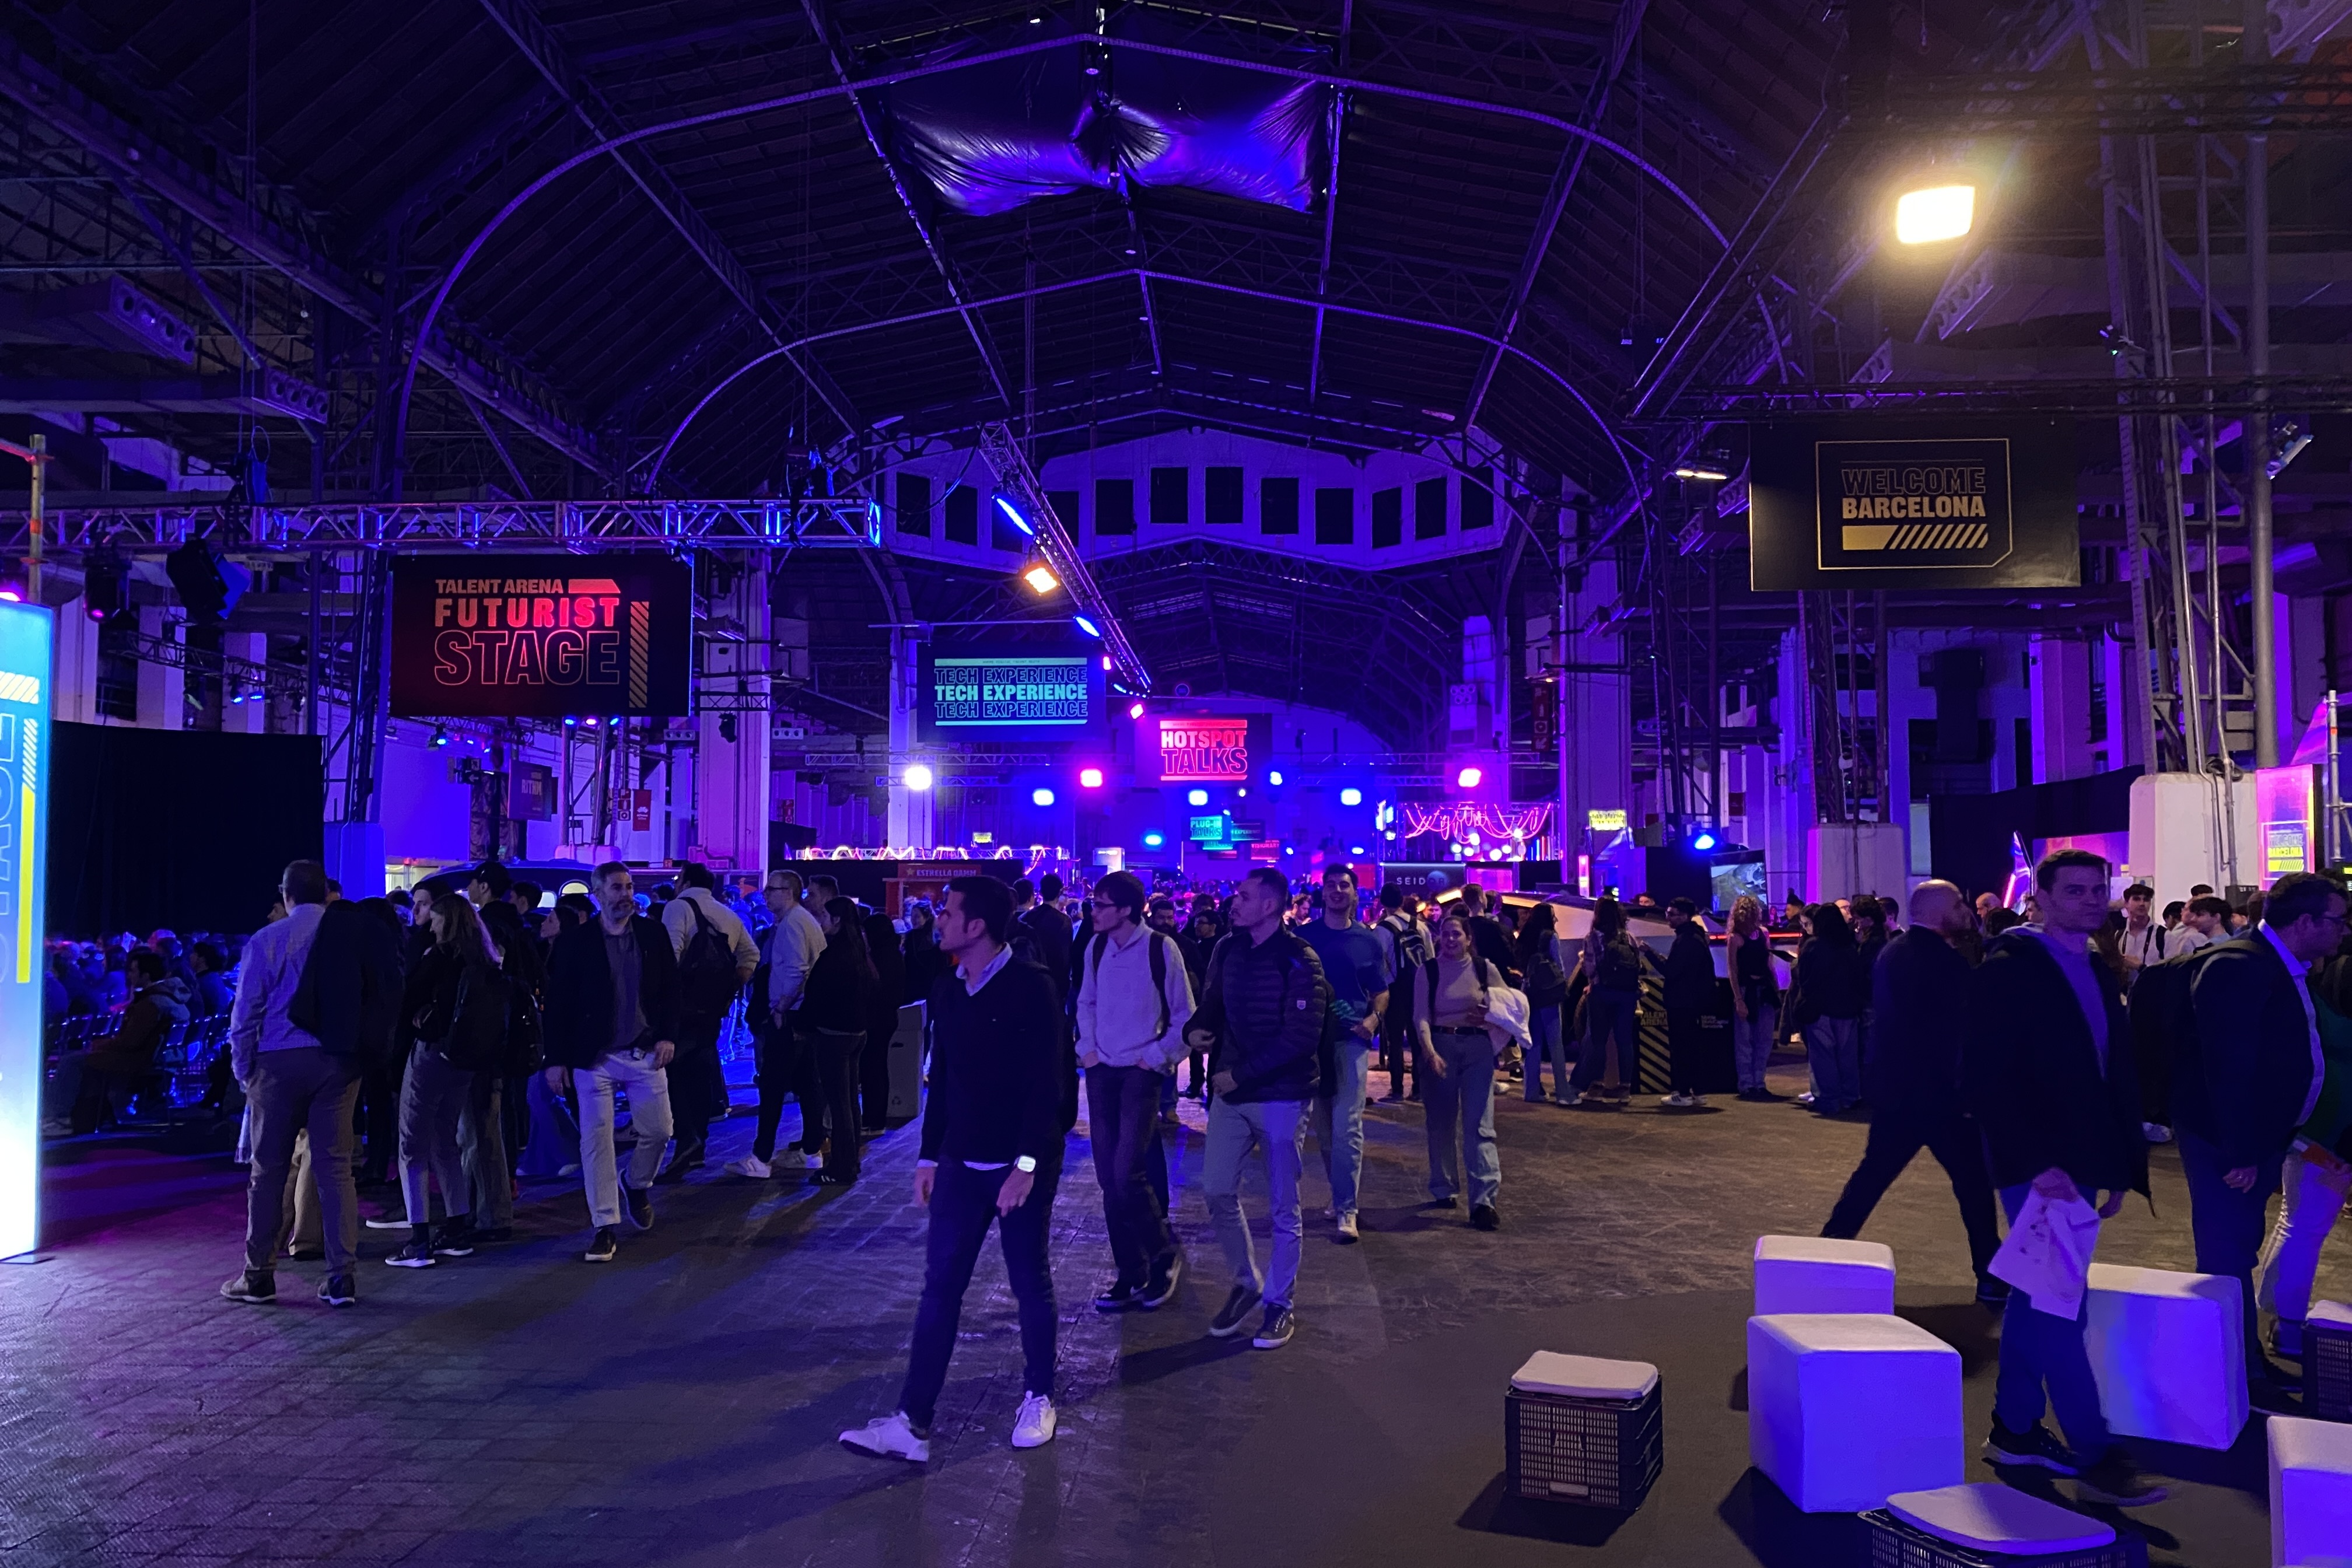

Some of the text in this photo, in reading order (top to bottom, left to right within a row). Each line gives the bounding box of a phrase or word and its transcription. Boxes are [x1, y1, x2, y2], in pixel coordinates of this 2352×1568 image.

[1842, 467, 1986, 495] WELCOME
[1842, 496, 1986, 519] BARCELONA
[436, 579, 564, 593] TALENT ARENA
[435, 597, 620, 627] FUTURIST
[435, 629, 620, 685] STAGE
[935, 667, 1087, 684] TECH EXPERIENCE
[935, 684, 1087, 701] TECH EXPERIENCE
[935, 701, 1088, 718] TECH EXPERIENCE
[1161, 730, 1247, 748] HOTSPOT
[1161, 747, 1247, 774] TALKS
[1191, 820, 1222, 828] PLUG-IN
[1191, 827, 1222, 836] TALKS
